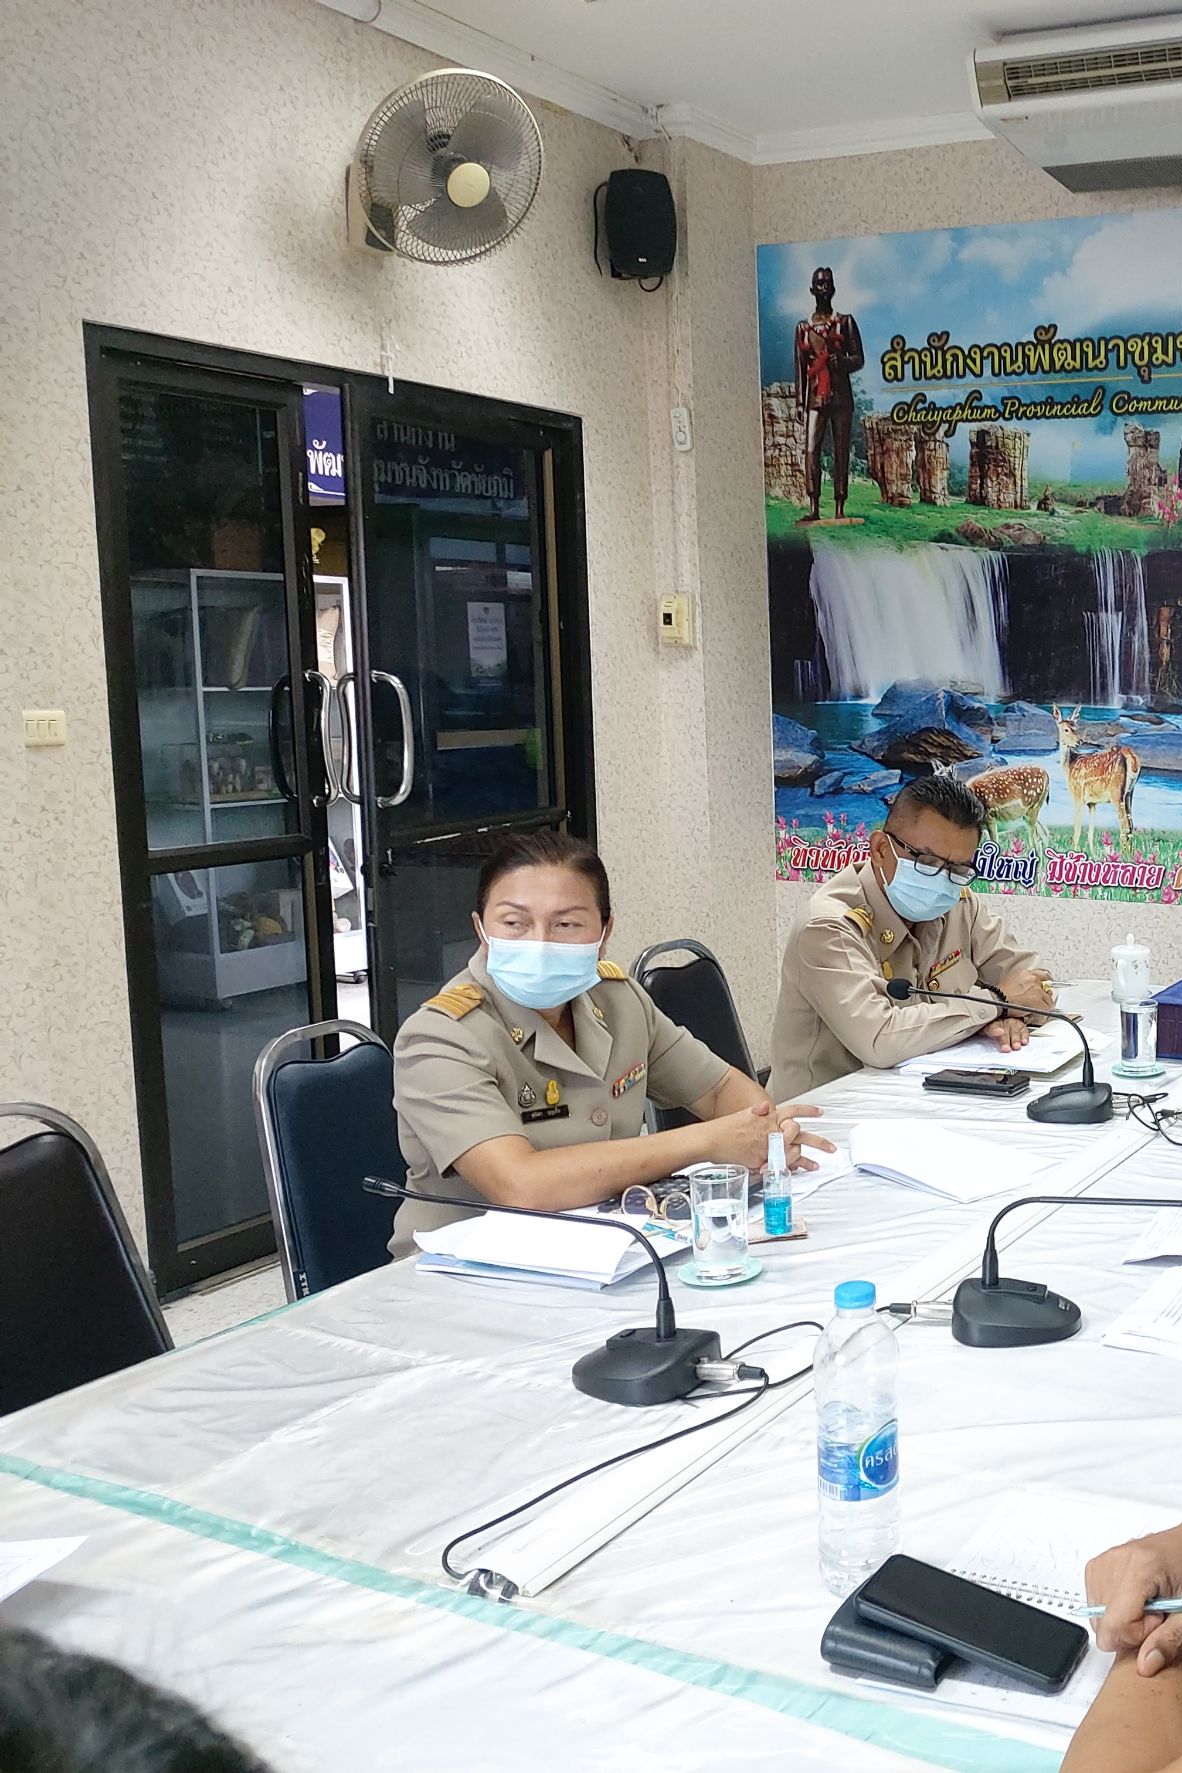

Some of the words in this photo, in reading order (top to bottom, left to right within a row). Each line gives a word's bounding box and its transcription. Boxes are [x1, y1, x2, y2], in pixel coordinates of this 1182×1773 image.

[892, 391, 999, 435] Chaiyaphum
[1003, 387, 1105, 419] Provincial
[306, 439, 344, 477] พัฒ
[791, 836, 870, 871] ทิวทัศน์
[1045, 848, 1166, 889] มีช้างหลาย
